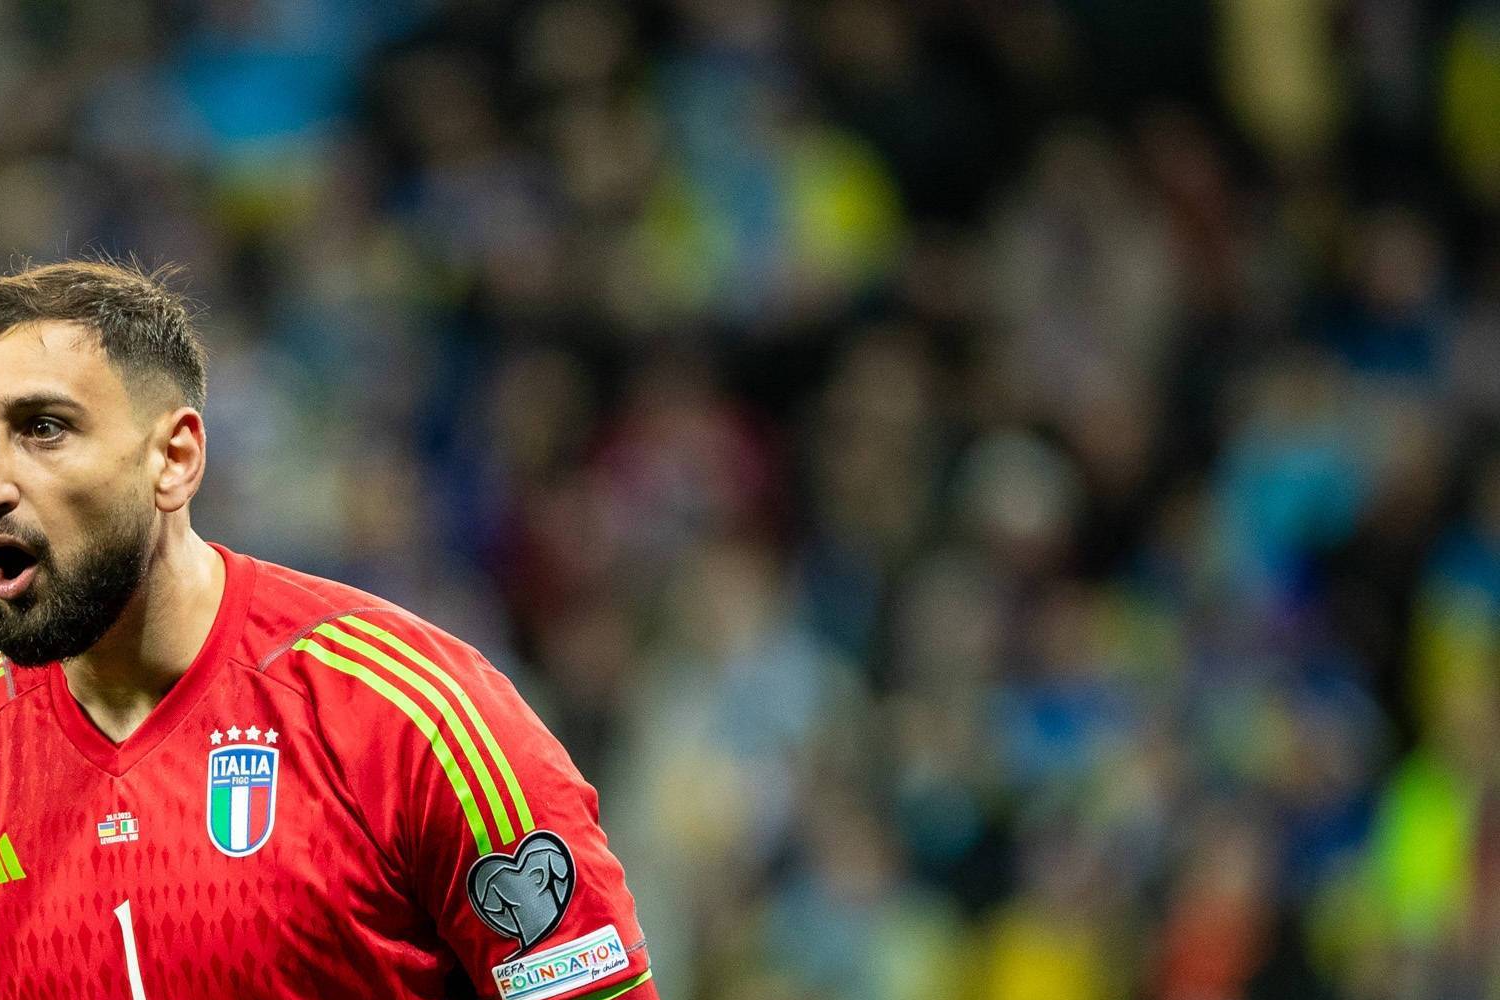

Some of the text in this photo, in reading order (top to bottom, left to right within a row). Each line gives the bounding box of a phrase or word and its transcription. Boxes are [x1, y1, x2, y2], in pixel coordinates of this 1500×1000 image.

[213, 755, 271, 776] ITALIA
[232, 777, 250, 785] FIGC
[497, 962, 525, 978] UEFA
[591, 958, 626, 980] for children
